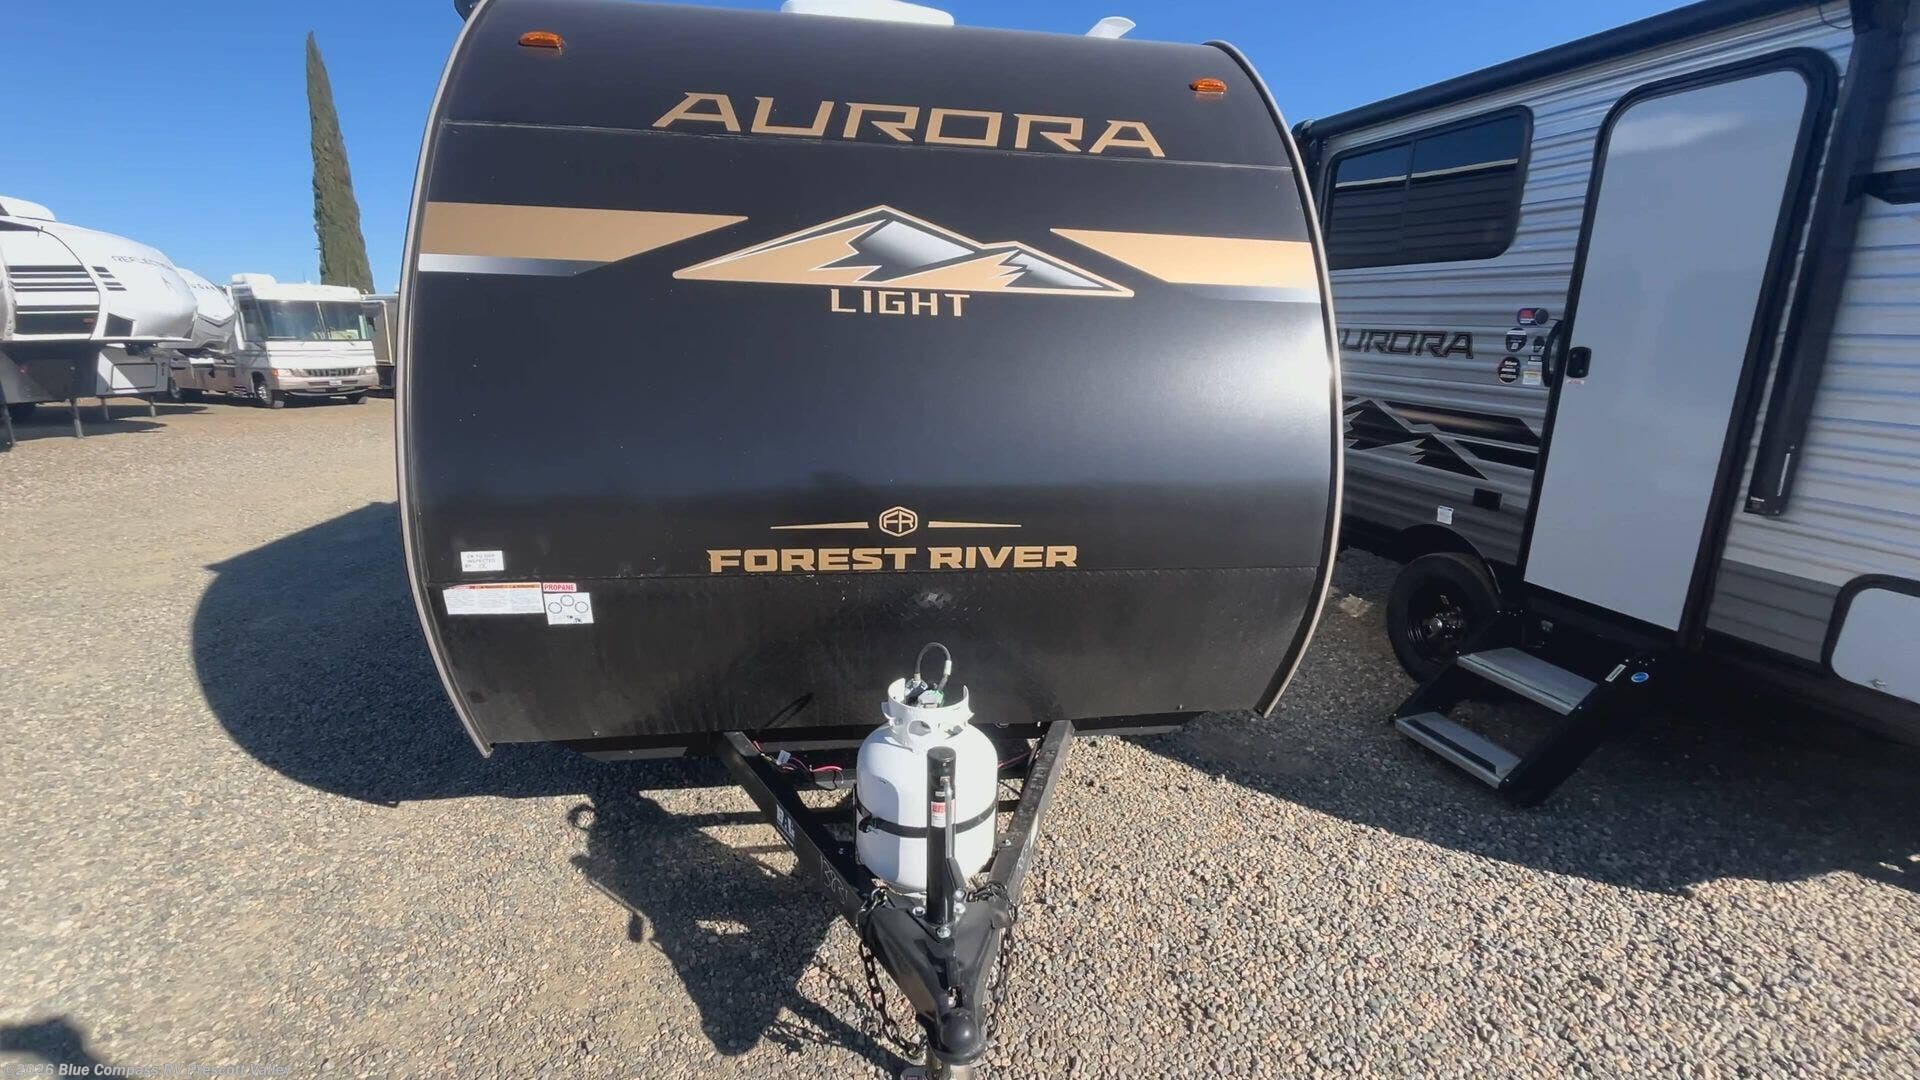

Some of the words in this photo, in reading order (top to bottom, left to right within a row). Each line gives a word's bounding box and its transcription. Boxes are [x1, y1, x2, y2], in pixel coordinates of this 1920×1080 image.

[652, 92, 1166, 158] AURORA
[830, 288, 971, 317] LIGHT
[706, 547, 917, 573] FOREST
[927, 545, 1078, 569] RIVER
[544, 583, 575, 591] PROPANE
